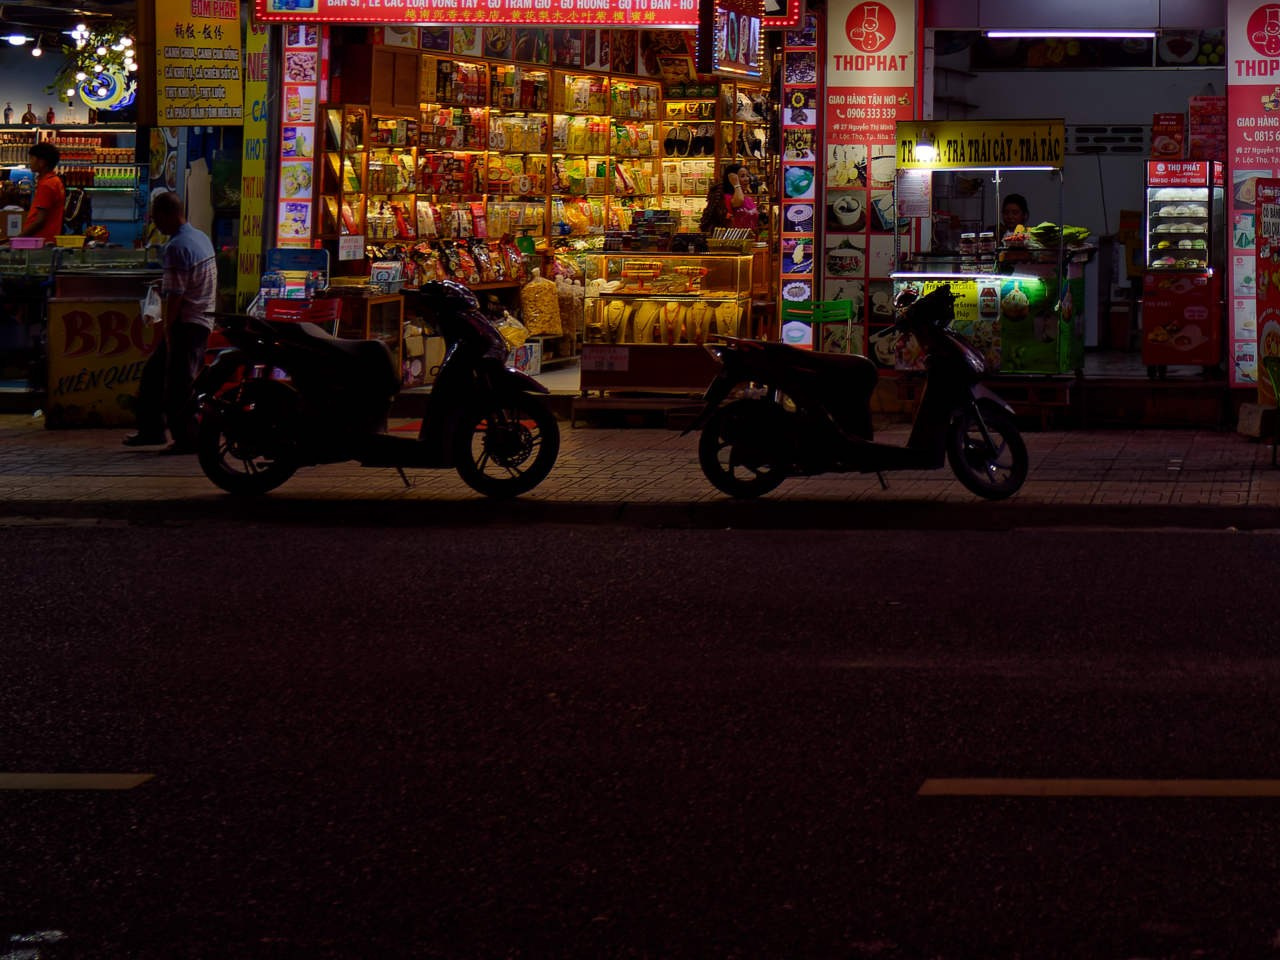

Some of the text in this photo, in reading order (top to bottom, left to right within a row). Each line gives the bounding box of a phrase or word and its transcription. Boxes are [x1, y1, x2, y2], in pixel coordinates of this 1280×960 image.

[846, 93, 867, 105] HÀNG
[846, 108, 896, 119] 0906 333 339
[1236, 117, 1256, 127] GIAO
[1257, 114, 1279, 127] HÀNG
[1254, 131, 1275, 141] 0815
[947, 132, 965, 163] TRÀ
[968, 131, 991, 162] TRÁI
[993, 131, 1012, 162] CÂY
[1019, 131, 1039, 162] TRÀ
[1182, 162, 1201, 171] PHÁT
